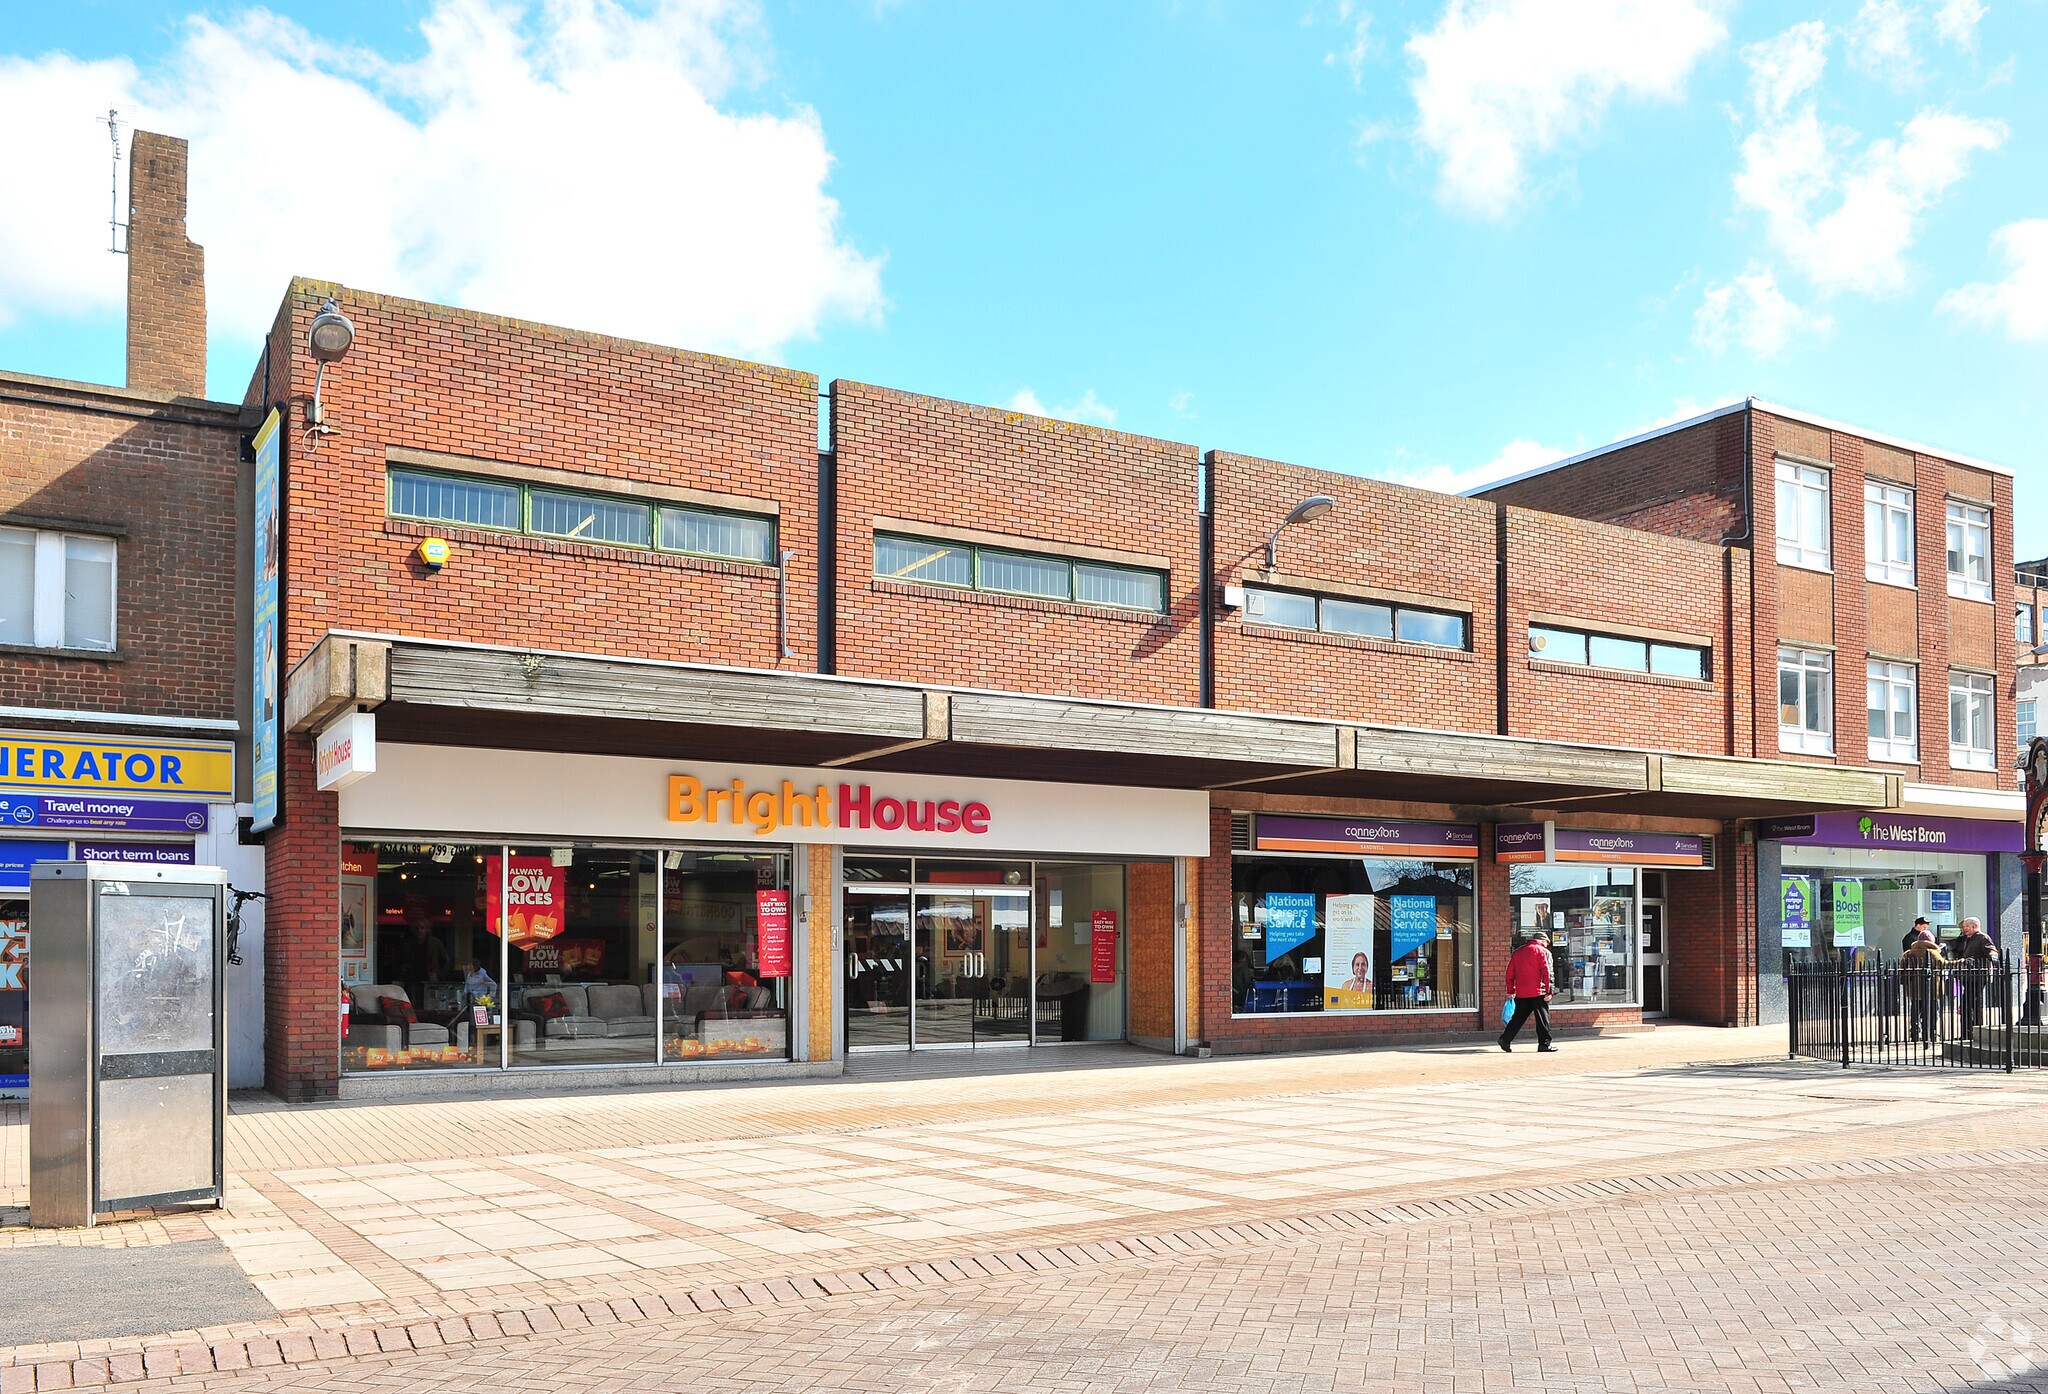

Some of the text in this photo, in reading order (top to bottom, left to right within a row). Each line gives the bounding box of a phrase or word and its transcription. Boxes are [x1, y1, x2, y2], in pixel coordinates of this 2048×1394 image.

[45, 800, 84, 813] Travel
[87, 803, 134, 817] money
[1345, 826, 1399, 840] connexions
[1499, 832, 1542, 844] connexions
[1872, 824, 1946, 844] the West Brom
[1589, 837, 1634, 850] connexions
[83, 848, 190, 862] Short term loans
[1269, 895, 1313, 906] National
[1393, 897, 1434, 908] National
[1835, 900, 1861, 912] Boost
[1270, 907, 1308, 918] Careers
[1393, 908, 1429, 919] Careers
[1270, 917, 1306, 928] Service
[1394, 919, 1428, 929] Service
[530, 949, 559, 960] LOW
